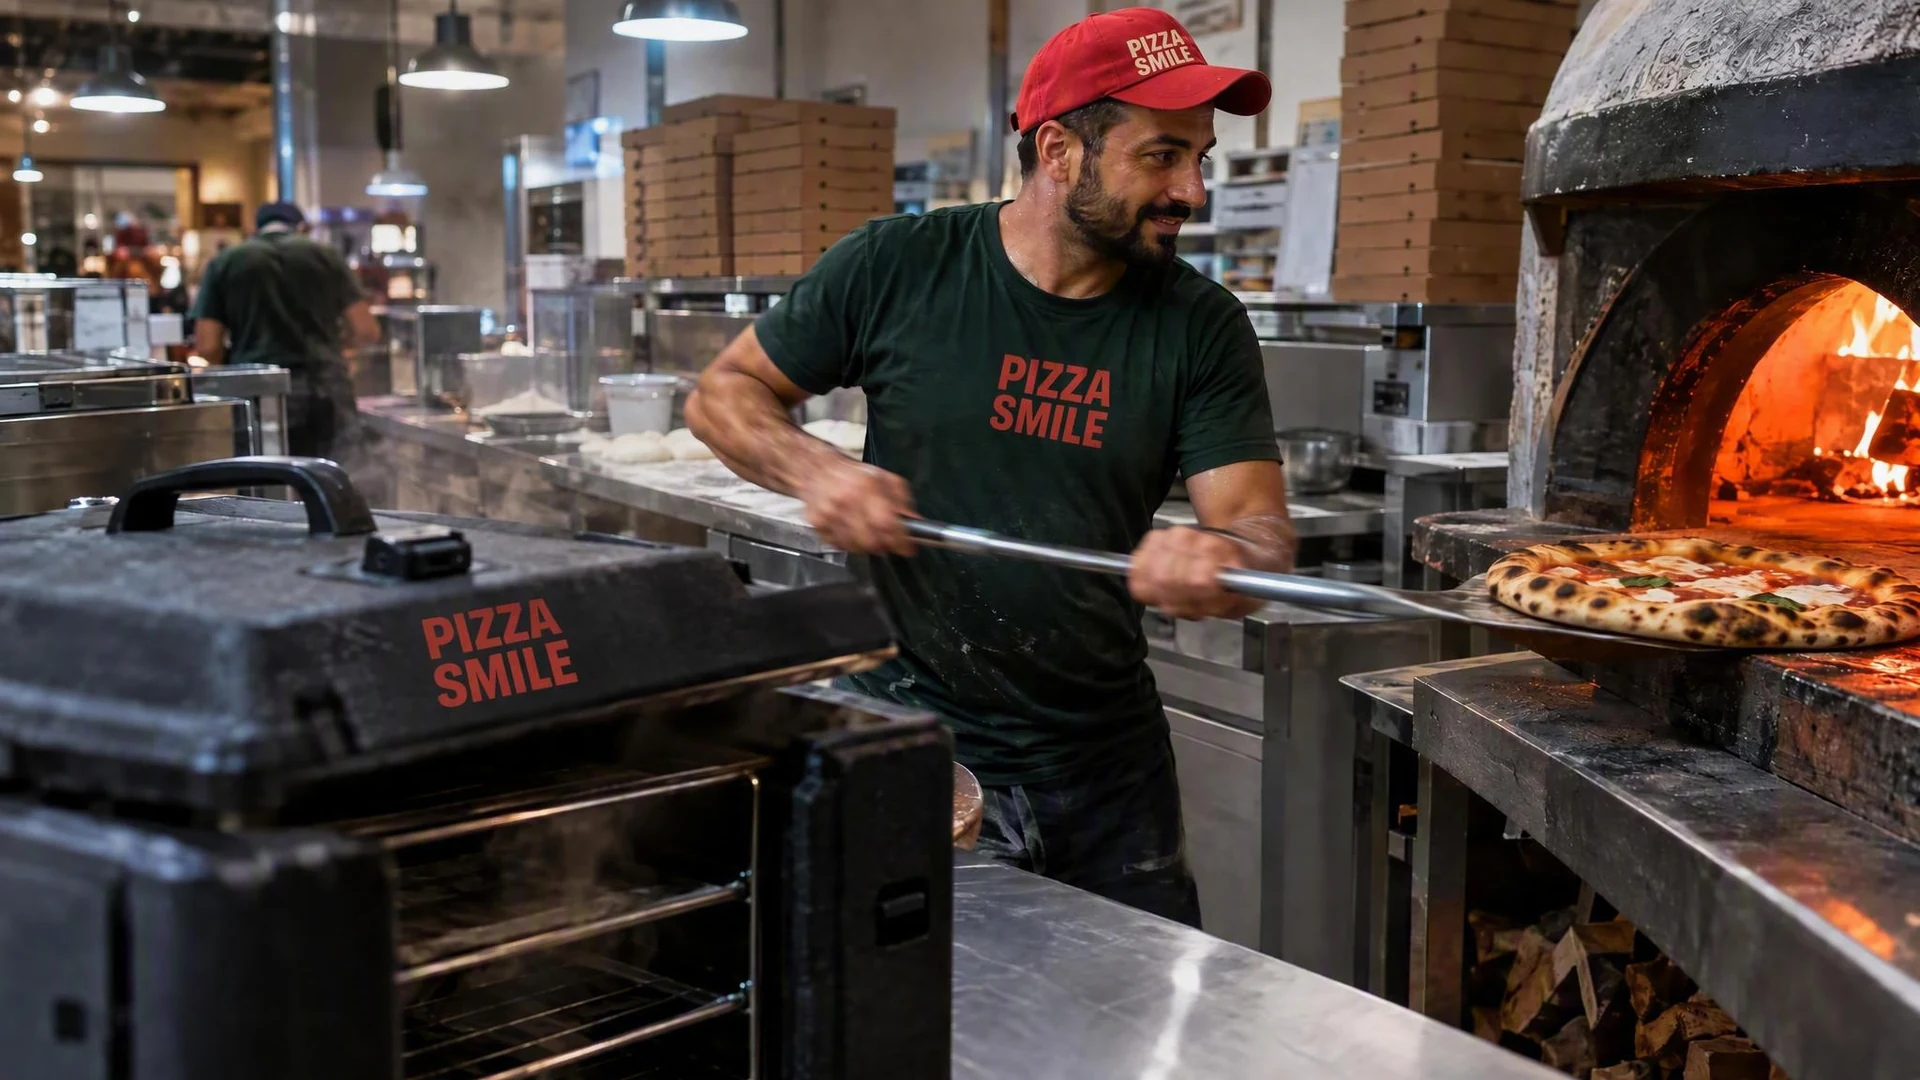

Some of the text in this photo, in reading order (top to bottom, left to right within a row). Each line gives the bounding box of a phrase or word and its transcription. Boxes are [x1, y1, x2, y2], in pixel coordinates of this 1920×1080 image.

[1127, 29, 1185, 58] PIZZA
[1134, 46, 1194, 76] SMILE
[997, 353, 1111, 408] PIZZA
[989, 394, 1108, 449] SMILE
[421, 598, 563, 660] PIZZA
[433, 639, 579, 708] SMILE
